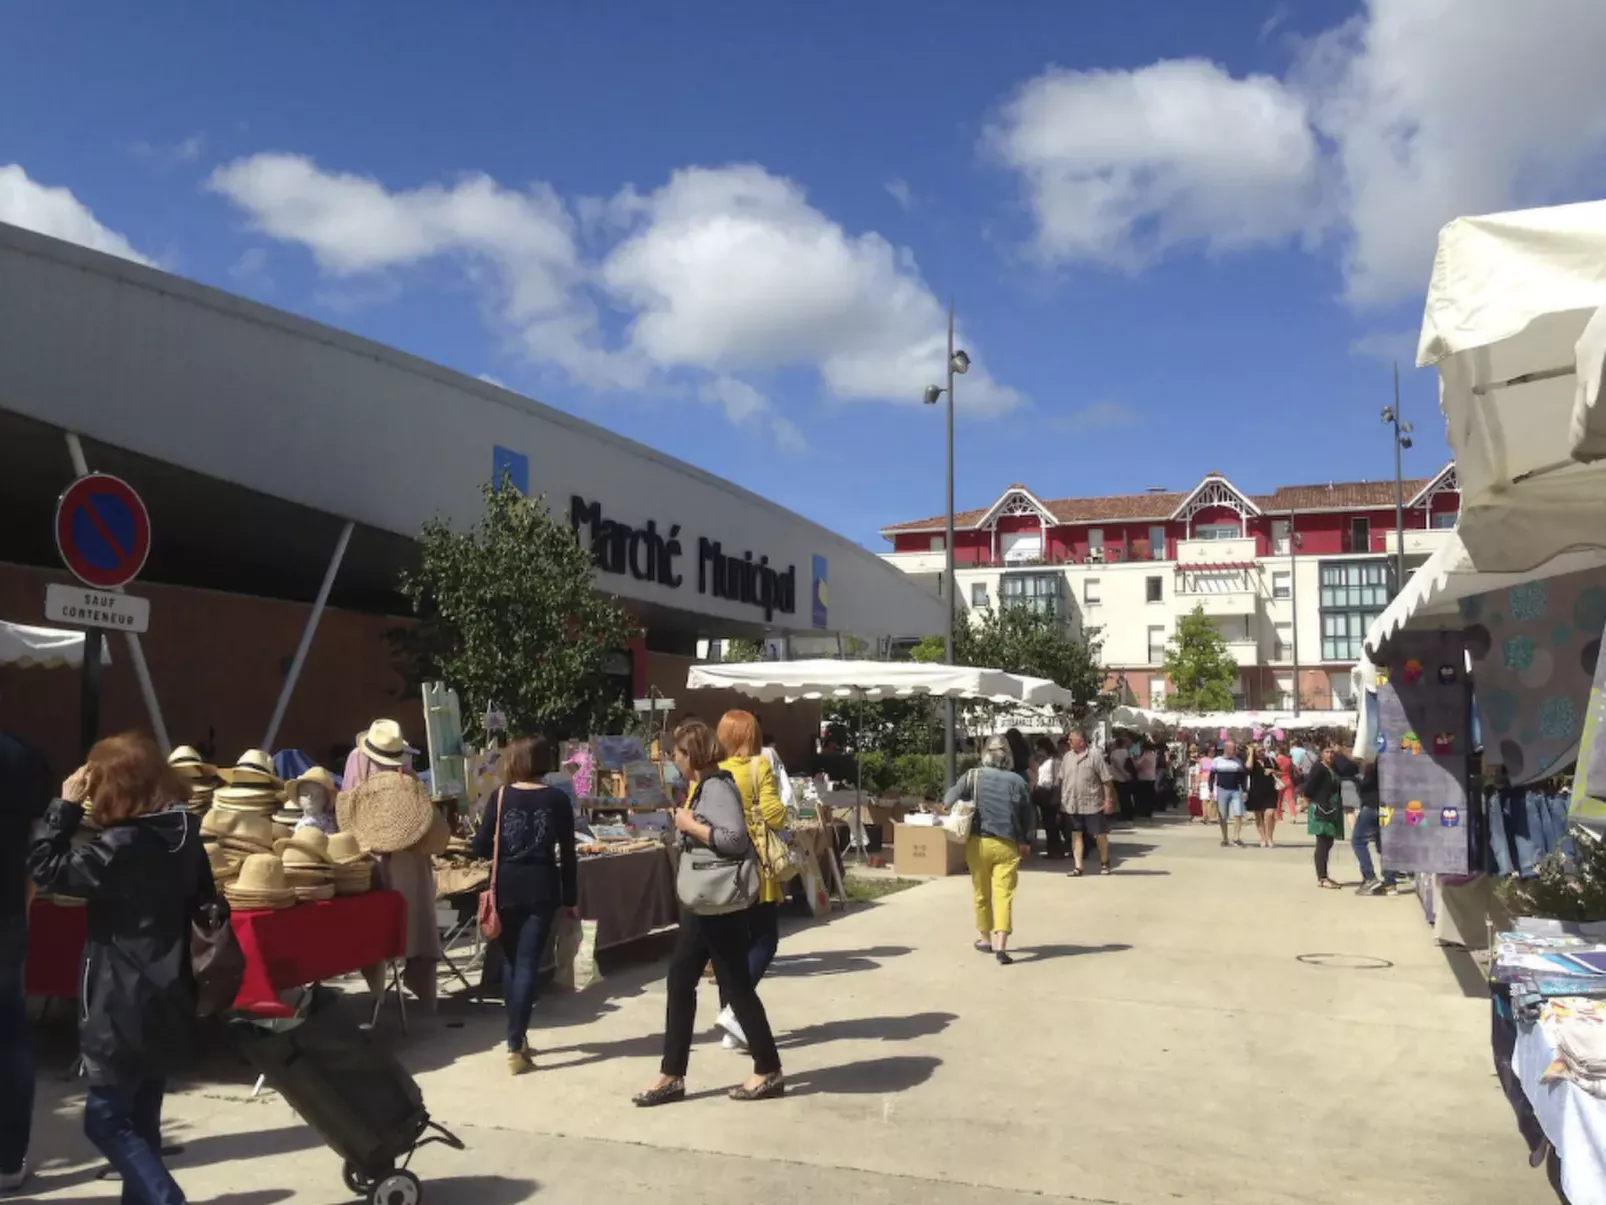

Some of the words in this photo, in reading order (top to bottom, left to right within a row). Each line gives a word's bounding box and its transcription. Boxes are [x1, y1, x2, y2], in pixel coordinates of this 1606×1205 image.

[570, 495, 683, 588] Marché
[697, 536, 796, 622] Municipal
[84, 594, 116, 609] SAUF
[62, 606, 135, 625] CONTENEUR
